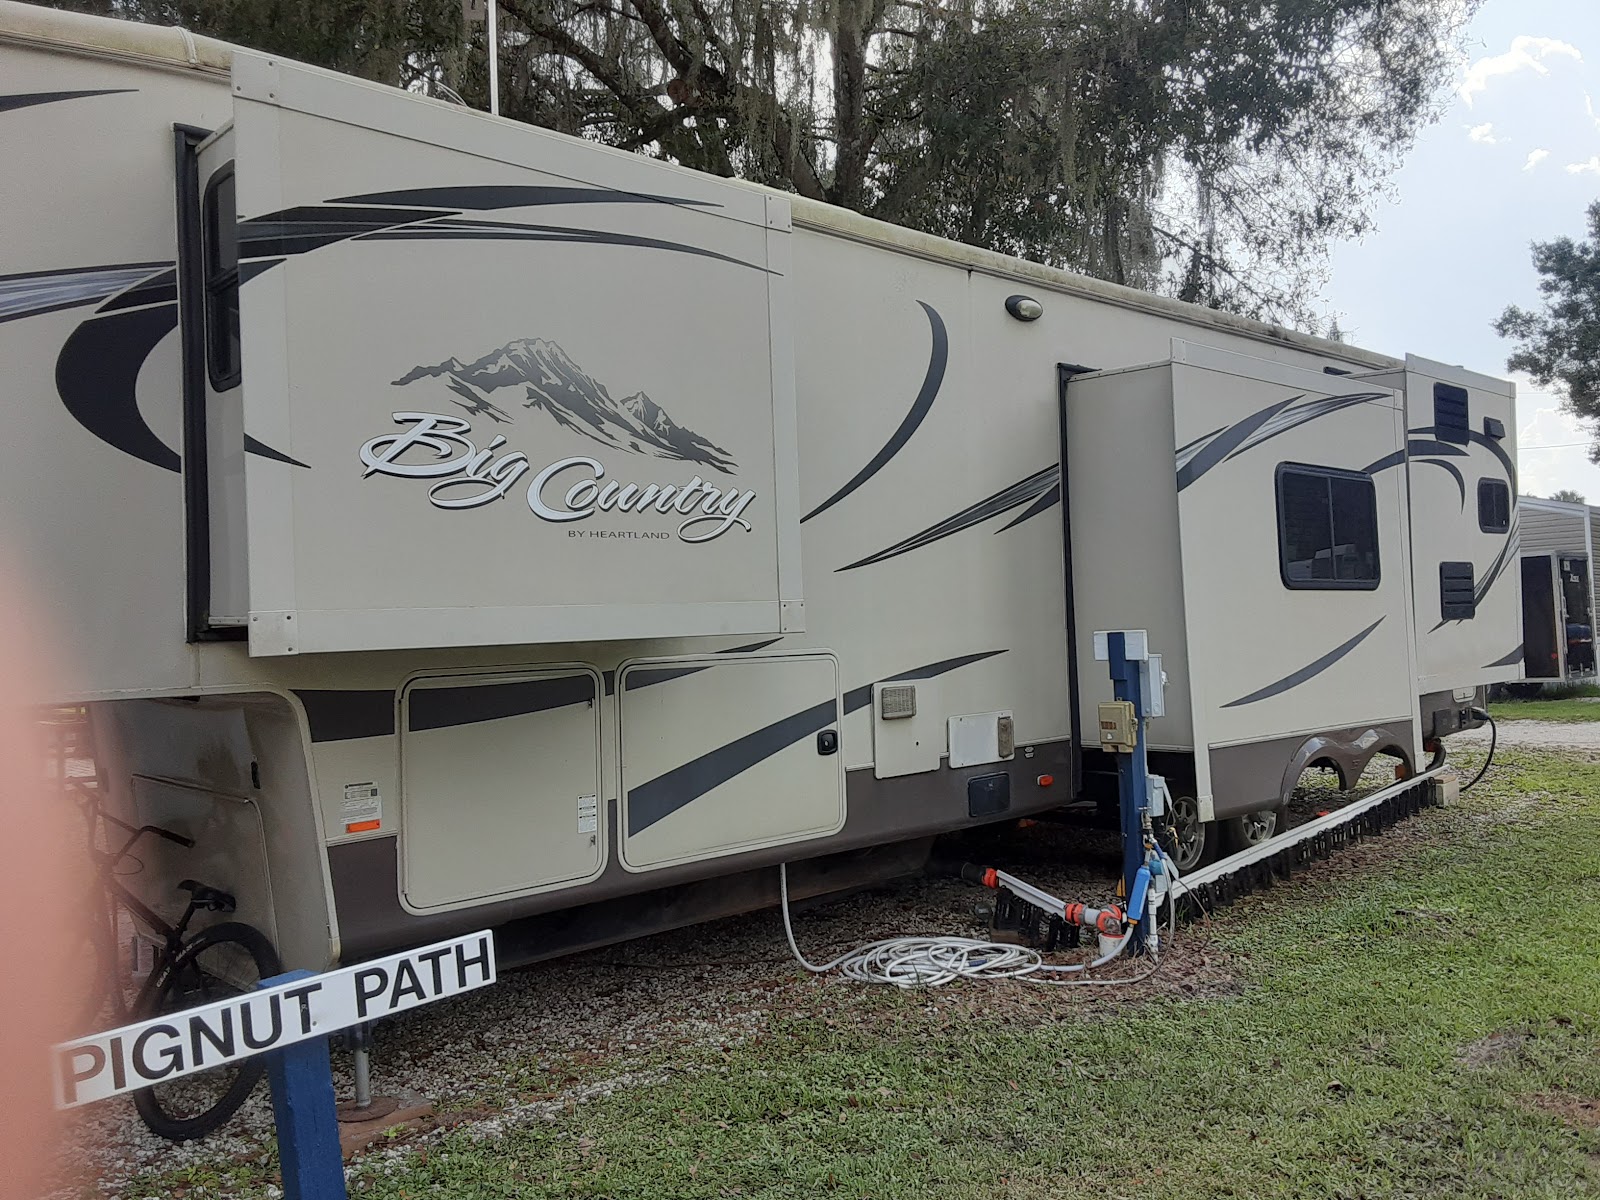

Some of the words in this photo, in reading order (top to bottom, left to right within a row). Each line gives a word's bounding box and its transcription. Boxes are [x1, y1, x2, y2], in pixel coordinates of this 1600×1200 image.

[359, 411, 530, 510] Big
[526, 456, 756, 544] Country
[568, 530, 586, 538] BY
[589, 530, 670, 540] HEARTLAND
[62, 982, 322, 1104] PIGNUT
[354, 937, 490, 1018] PATH
